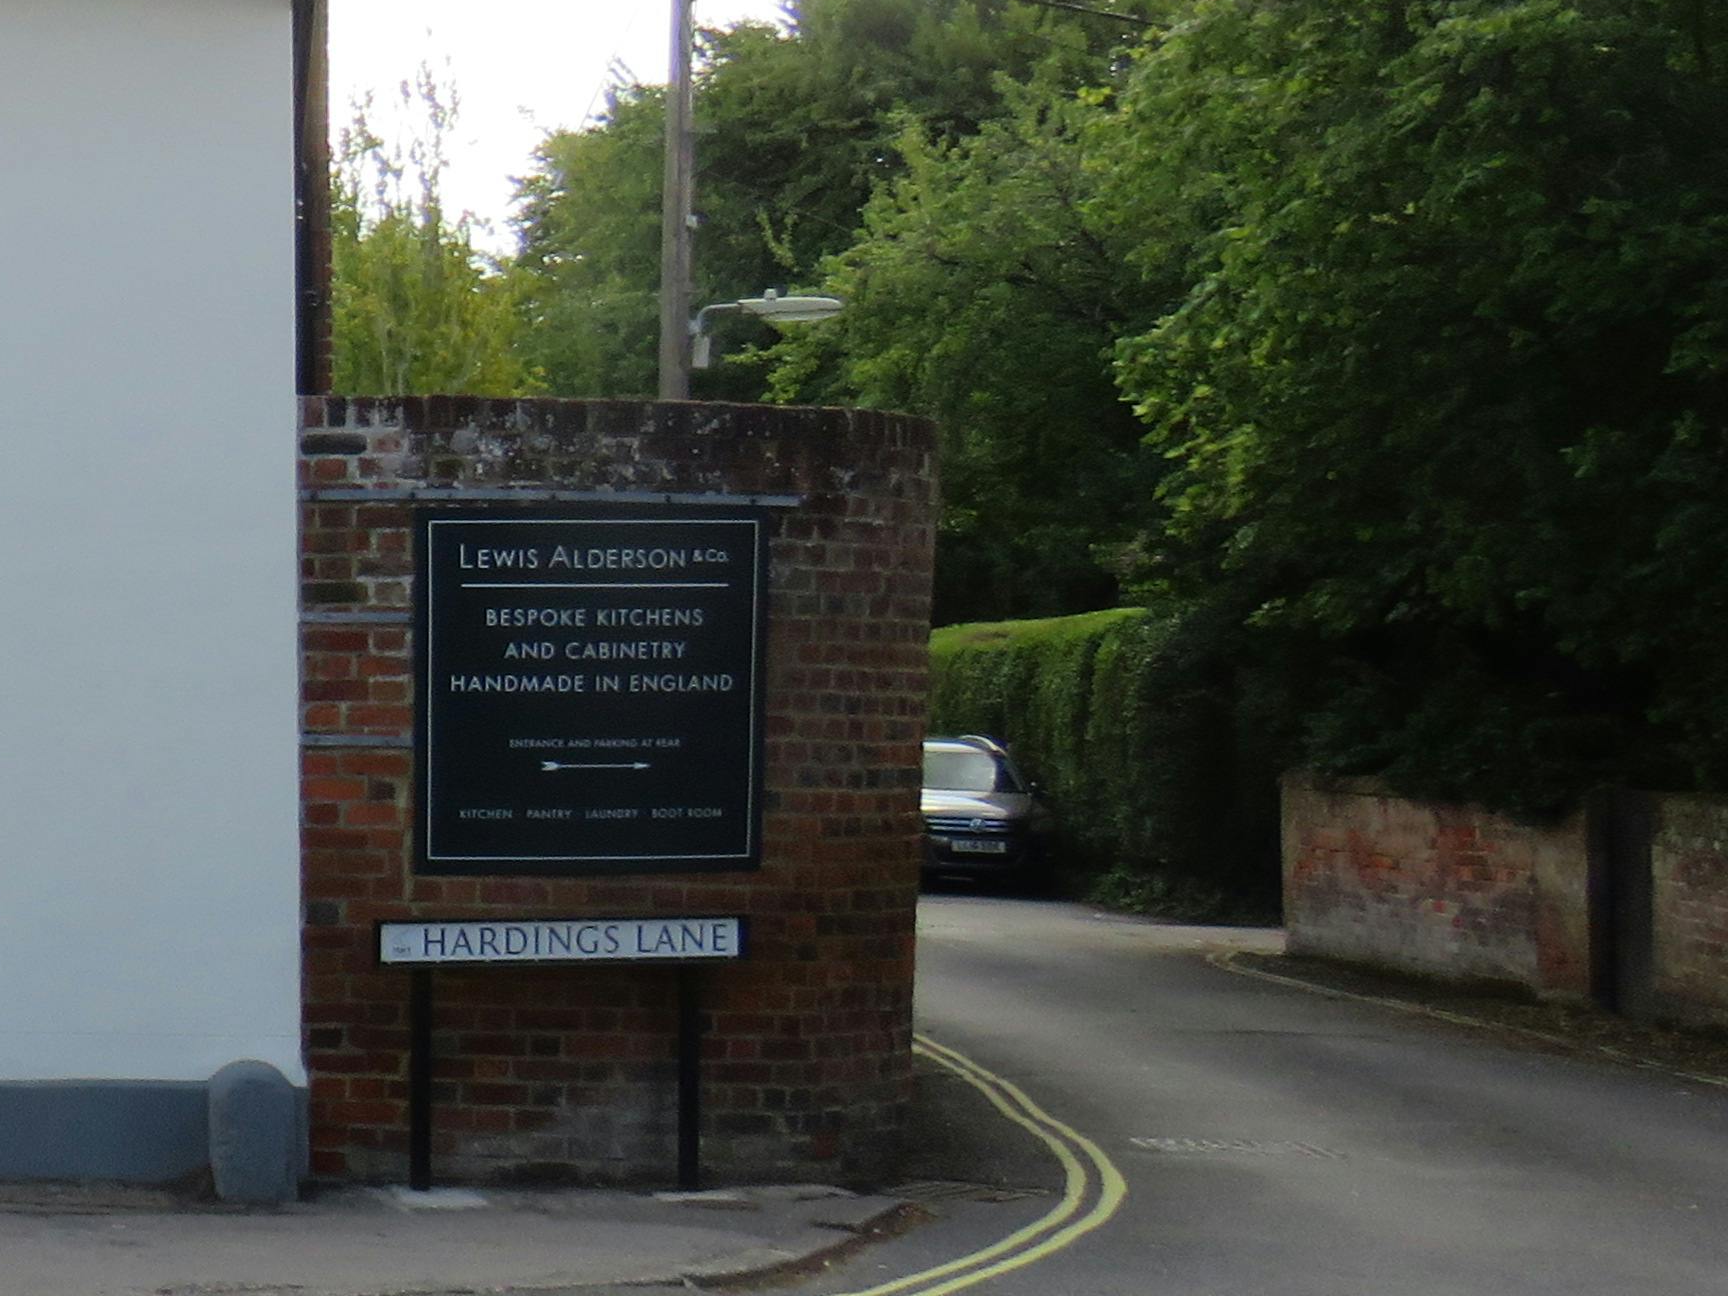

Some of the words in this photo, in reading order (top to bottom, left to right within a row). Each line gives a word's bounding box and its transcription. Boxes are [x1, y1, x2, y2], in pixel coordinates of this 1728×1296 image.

[459, 544, 539, 569] LEWIS
[548, 545, 686, 569] ALDERSON
[485, 608, 586, 627] BESPOKE
[596, 608, 704, 627] KITCHENS
[503, 642, 555, 660] AND
[565, 641, 687, 660] CABINETRY
[450, 675, 584, 692] HANDMADE
[595, 675, 619, 692] IN
[629, 674, 733, 692] ENGLAND
[458, 808, 513, 819] KITCHEN
[526, 808, 573, 819] PANTRY
[585, 808, 639, 819] LAUNDRY
[423, 925, 621, 956] HARDINGS
[636, 923, 729, 954] LANE
